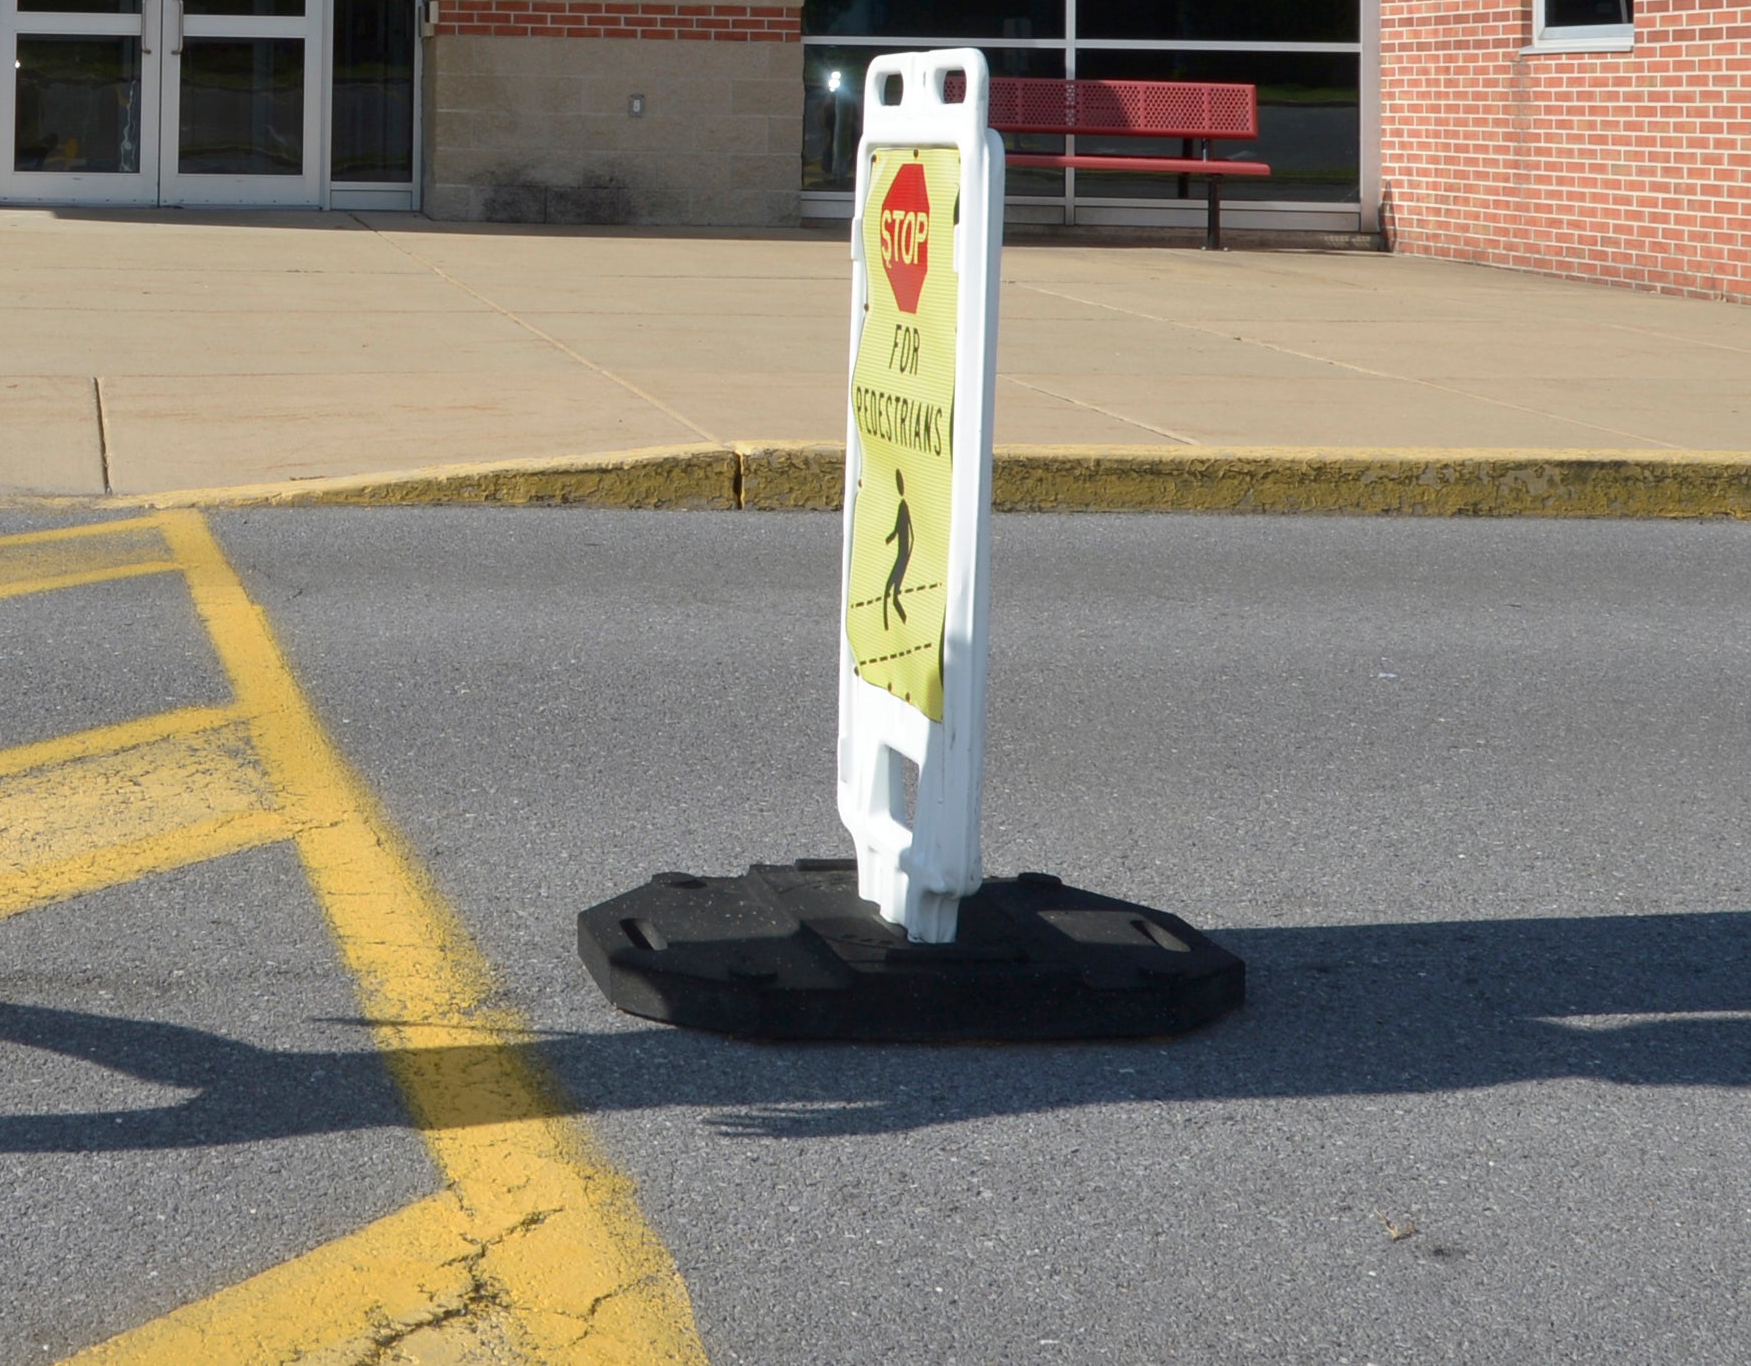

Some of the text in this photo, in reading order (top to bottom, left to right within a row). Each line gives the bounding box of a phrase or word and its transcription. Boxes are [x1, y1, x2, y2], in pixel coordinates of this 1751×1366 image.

[881, 209, 929, 269] STOP
[888, 324, 921, 376] FOR
[855, 386, 943, 457] PEDESTRIANS
